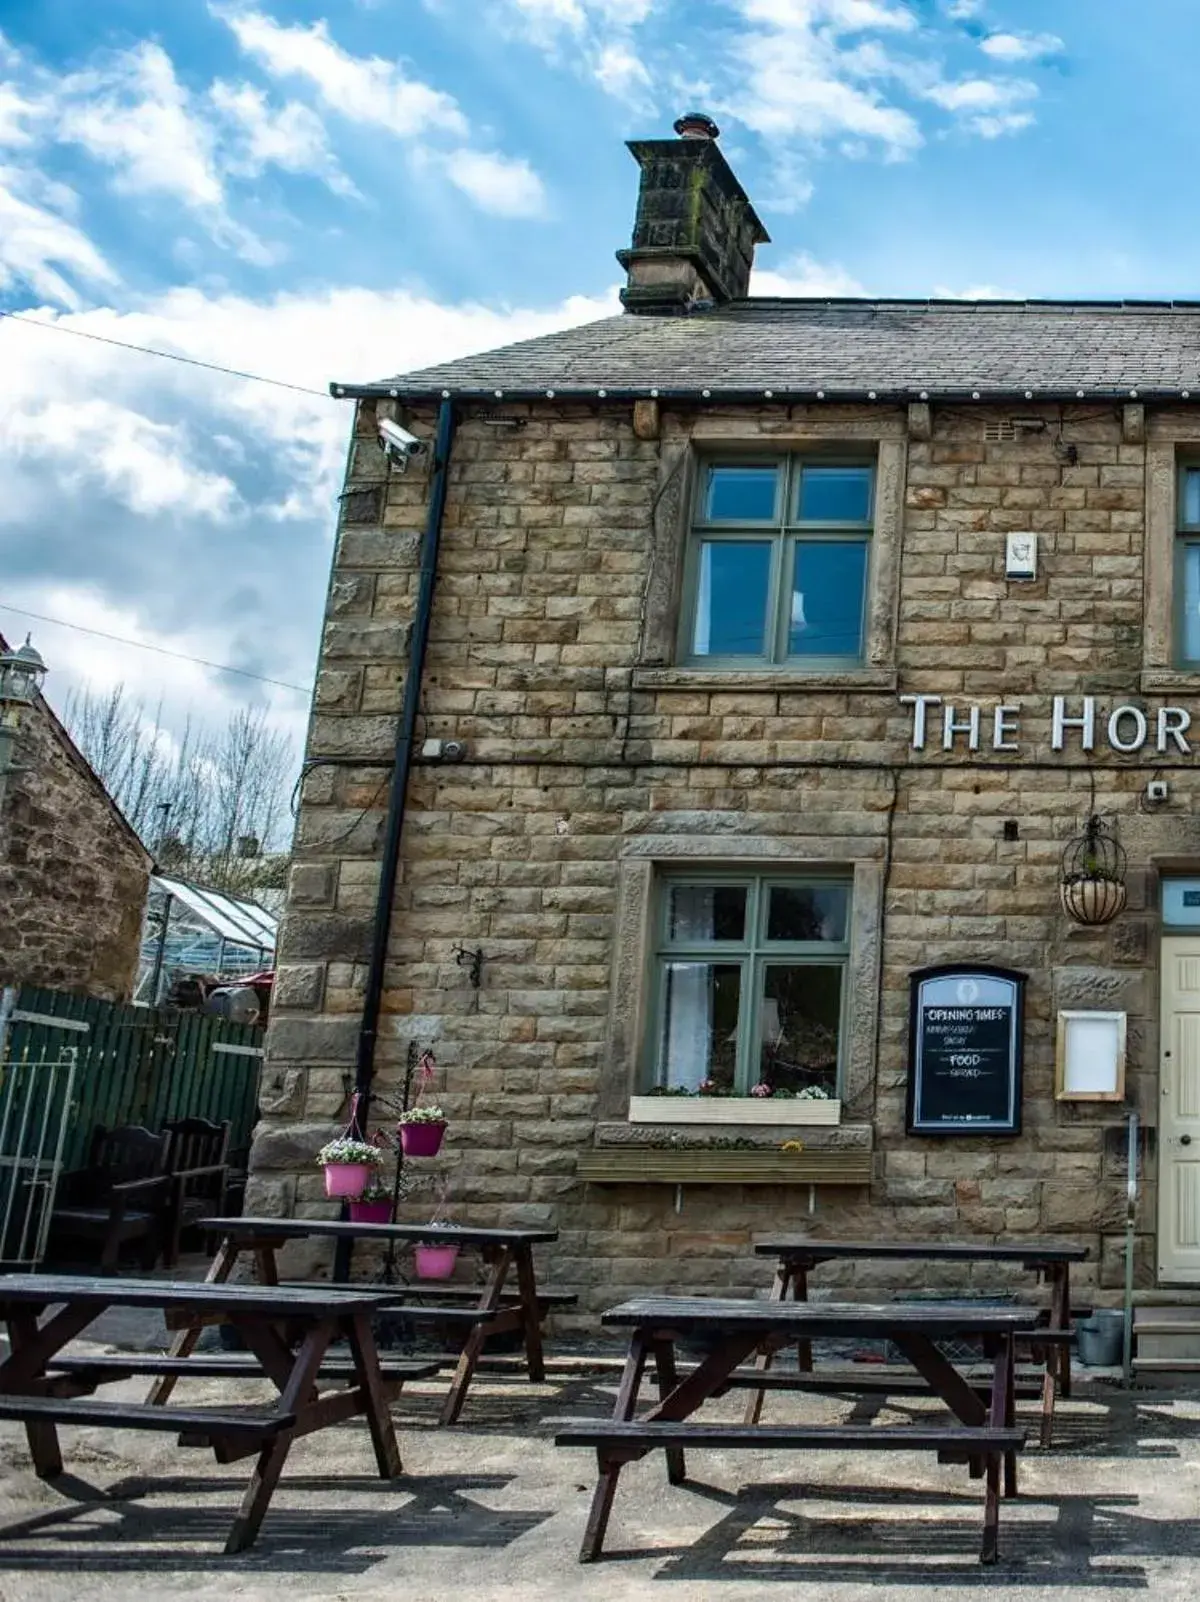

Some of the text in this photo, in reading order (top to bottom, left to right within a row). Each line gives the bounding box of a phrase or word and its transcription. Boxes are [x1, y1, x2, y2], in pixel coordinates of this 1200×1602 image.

[899, 695, 1021, 752] THE
[928, 1008, 974, 1020] OPENING
[949, 1053, 981, 1066] FOOD
